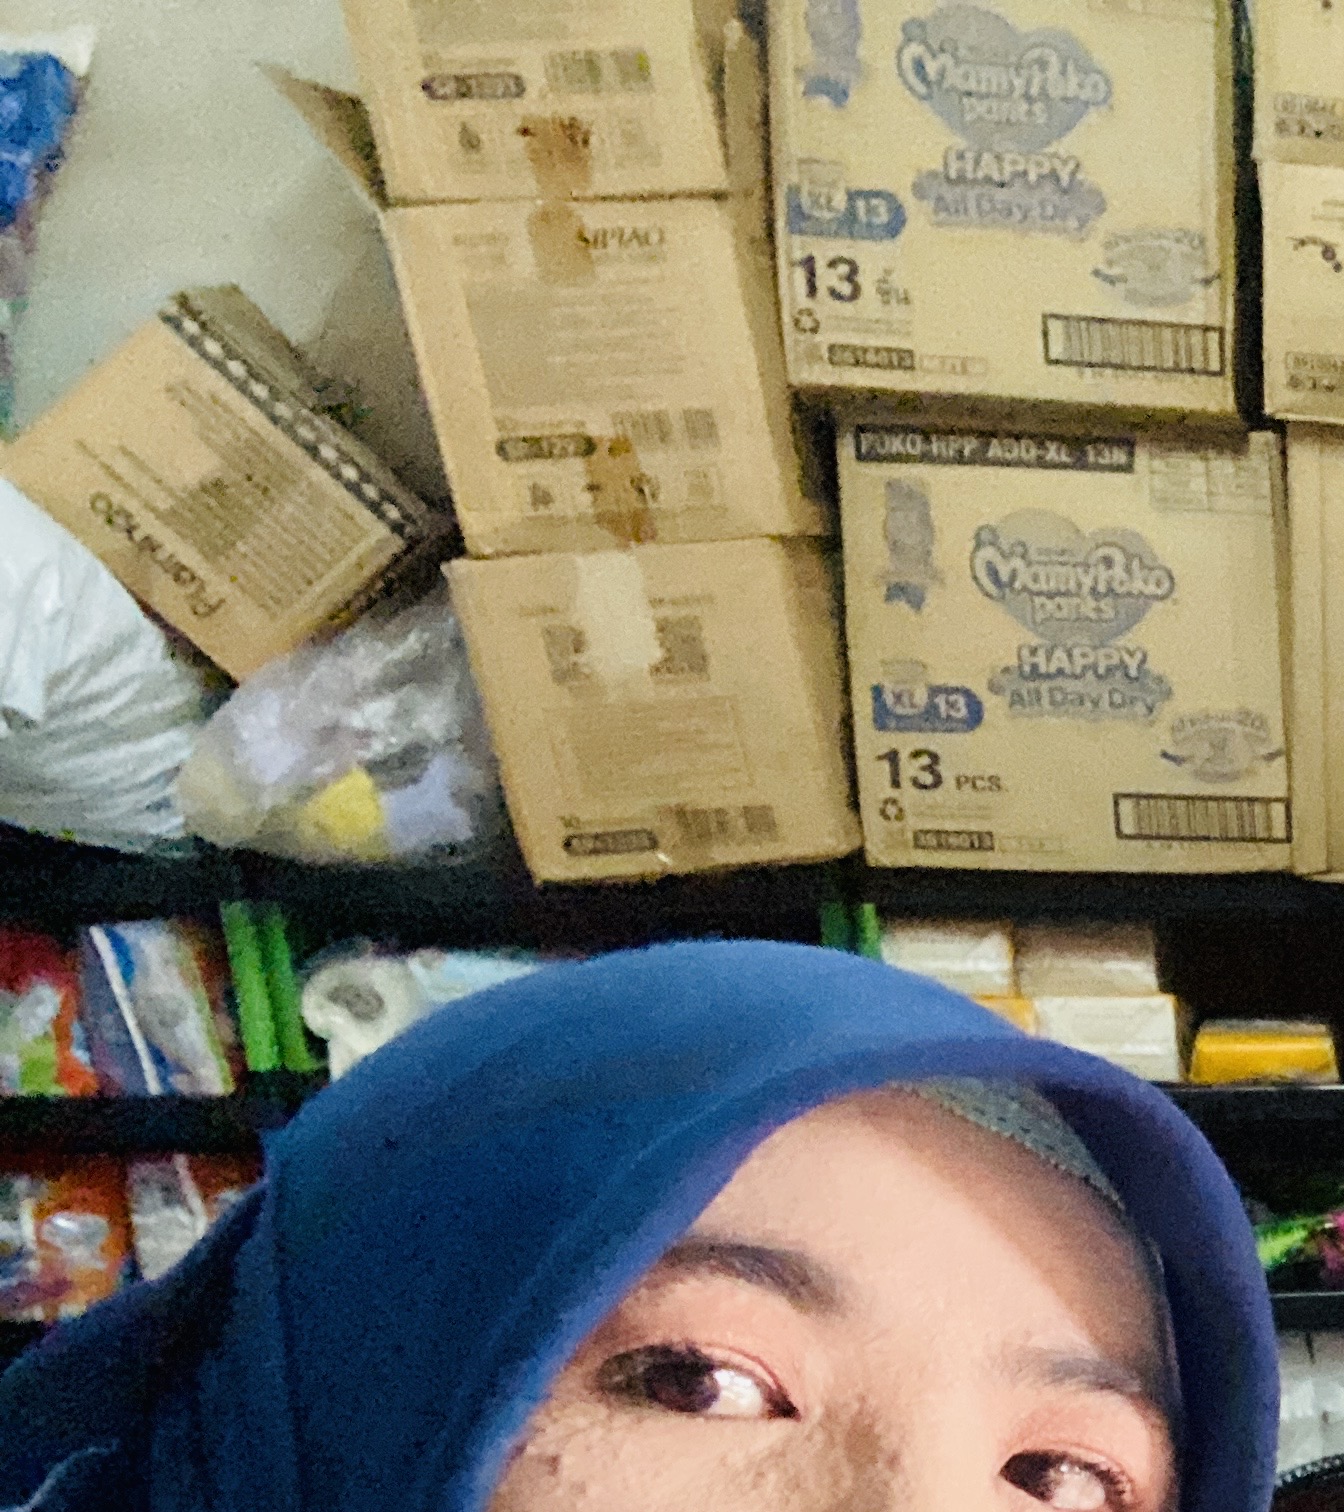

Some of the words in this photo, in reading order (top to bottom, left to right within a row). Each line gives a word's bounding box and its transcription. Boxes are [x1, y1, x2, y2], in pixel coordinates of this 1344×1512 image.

[945, 147, 1081, 188] HAPPY
[790, 254, 863, 303] 13
[1017, 644, 1149, 681] HAPPY
[938, 693, 968, 719] 13
[875, 748, 943, 791] 13
